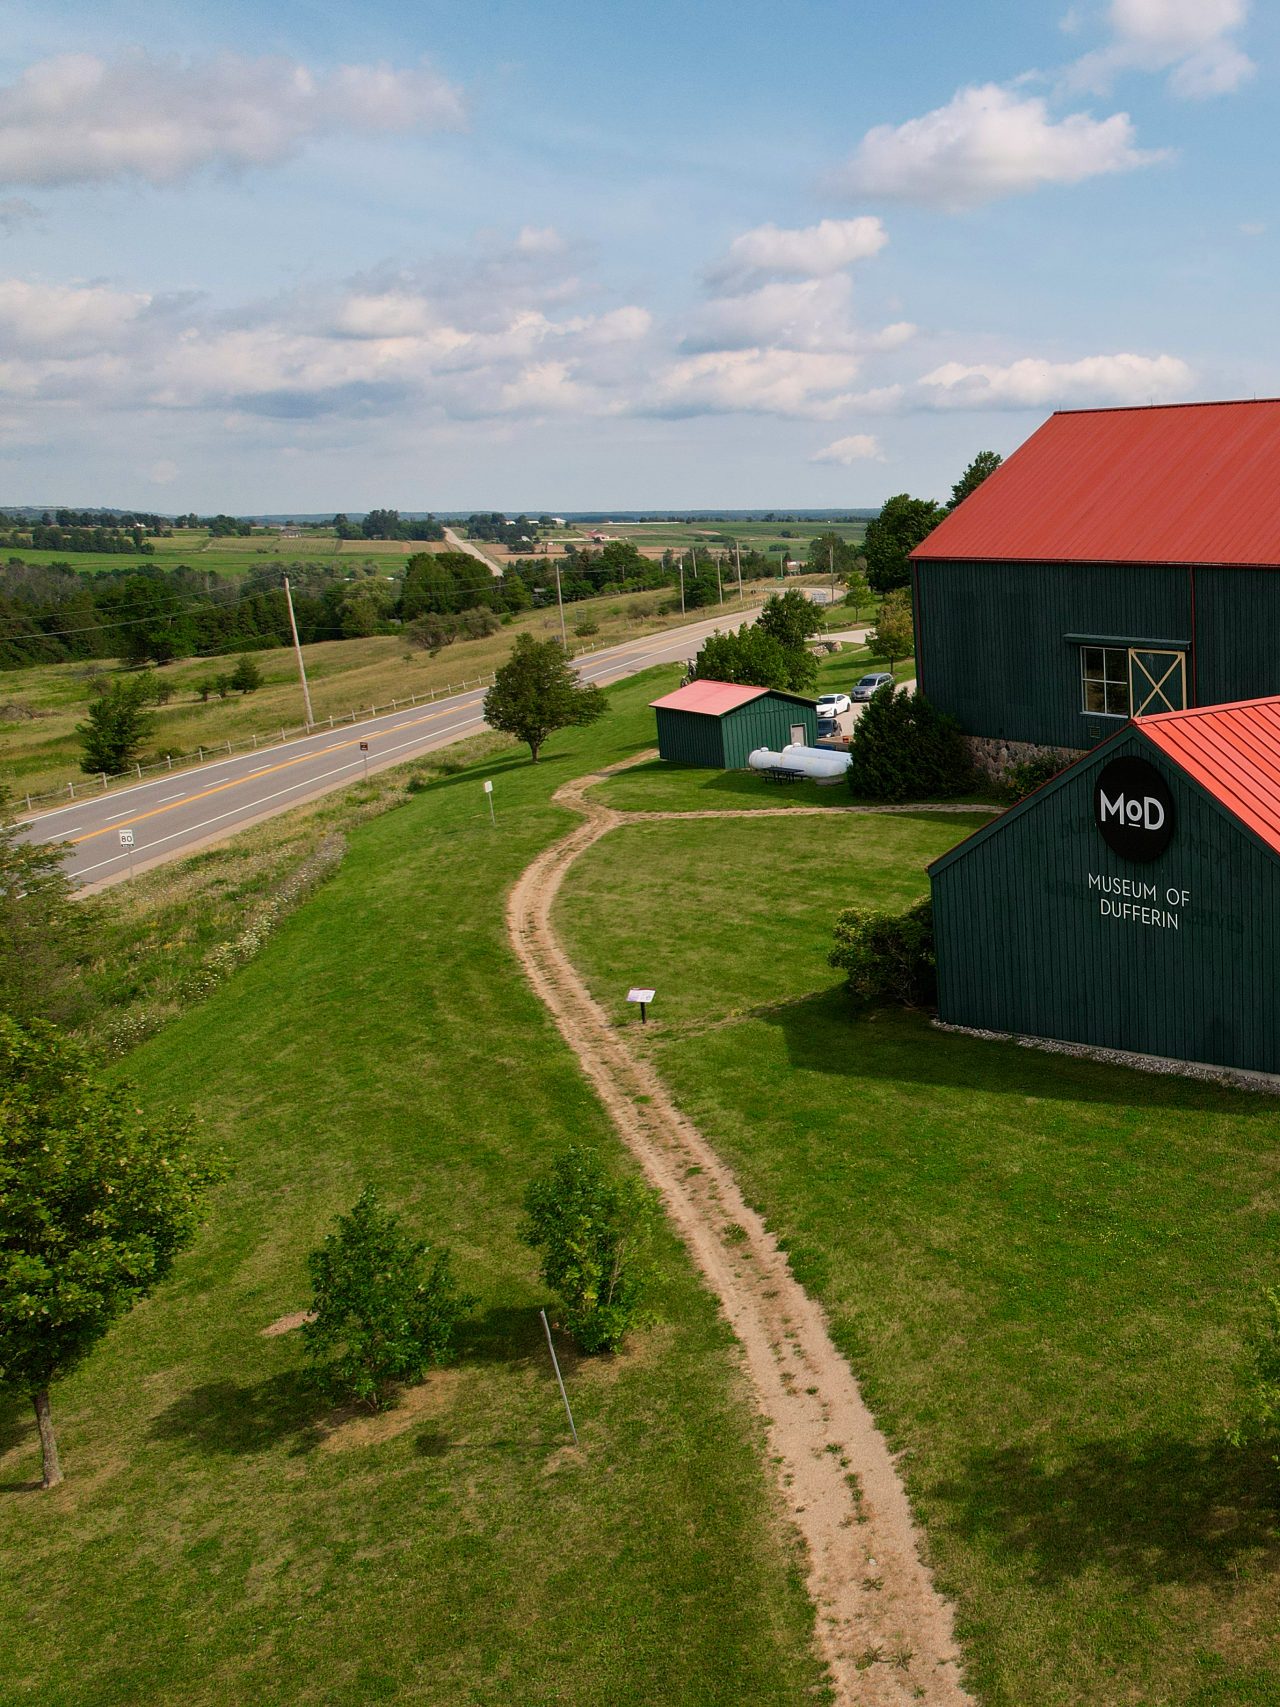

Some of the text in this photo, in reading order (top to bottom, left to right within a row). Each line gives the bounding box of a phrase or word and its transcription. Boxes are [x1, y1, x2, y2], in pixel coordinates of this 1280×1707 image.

[1100, 789, 1164, 830] MoD
[1088, 873, 1156, 901] MUSEUM
[1166, 888, 1190, 907] OF
[1100, 899, 1179, 930] DUFFERIN
